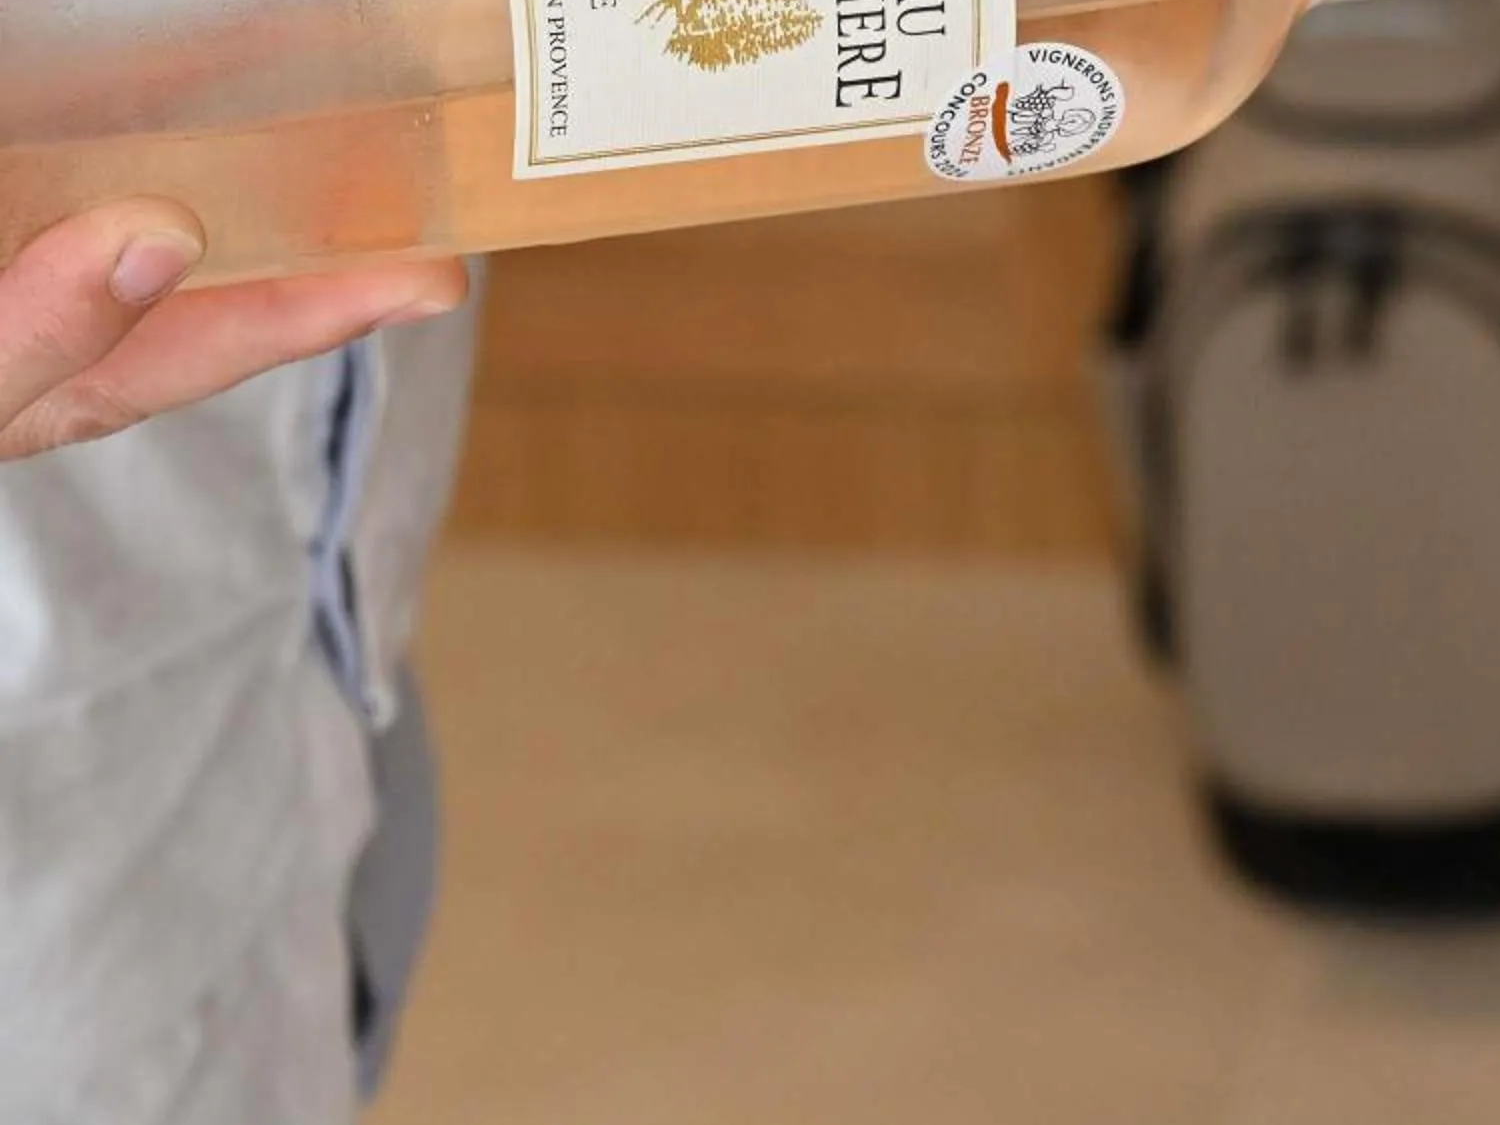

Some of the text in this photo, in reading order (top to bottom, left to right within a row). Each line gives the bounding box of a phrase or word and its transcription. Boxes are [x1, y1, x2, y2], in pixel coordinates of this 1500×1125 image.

[547, 17, 569, 138] PROVENCE
[1029, 49, 1116, 102] VIGNERONS
[930, 72, 988, 163] CONCOURS
[959, 94, 990, 165] BRONZE
